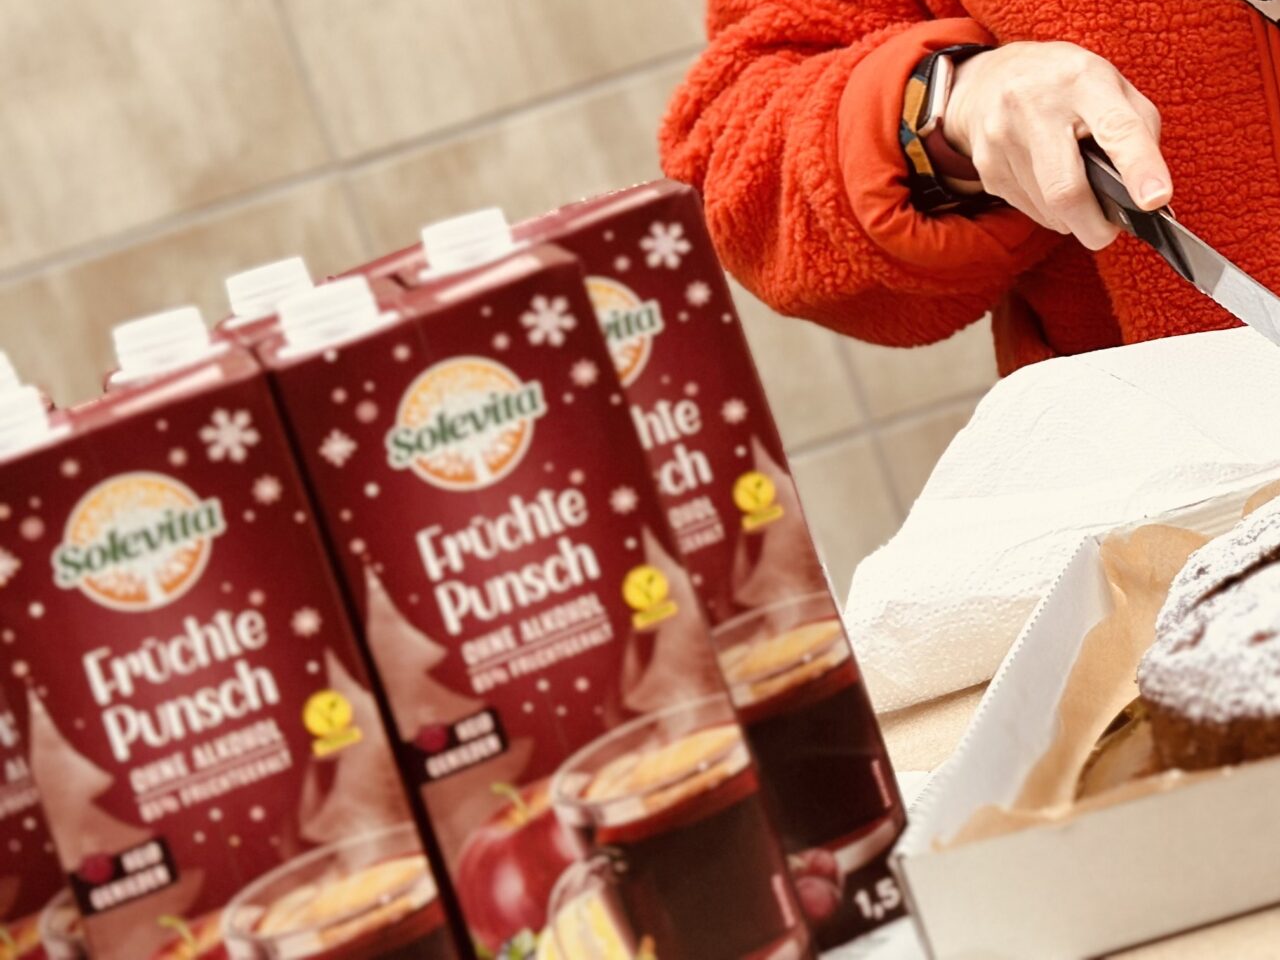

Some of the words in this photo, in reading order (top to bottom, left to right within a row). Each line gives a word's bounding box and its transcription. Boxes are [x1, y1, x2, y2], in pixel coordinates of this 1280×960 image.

[391, 386, 541, 463] Solevita
[57, 502, 220, 582] Solevita
[415, 488, 589, 582] Früchte
[434, 536, 601, 637] Punsch
[82, 609, 268, 706] Früchte
[461, 624, 517, 666] OHNE
[519, 592, 606, 643] ALKOHOL
[102, 658, 280, 762] Punsch
[129, 752, 189, 793] OHNE
[191, 717, 286, 770] ALKOHOL
[855, 878, 900, 920] 1,5
